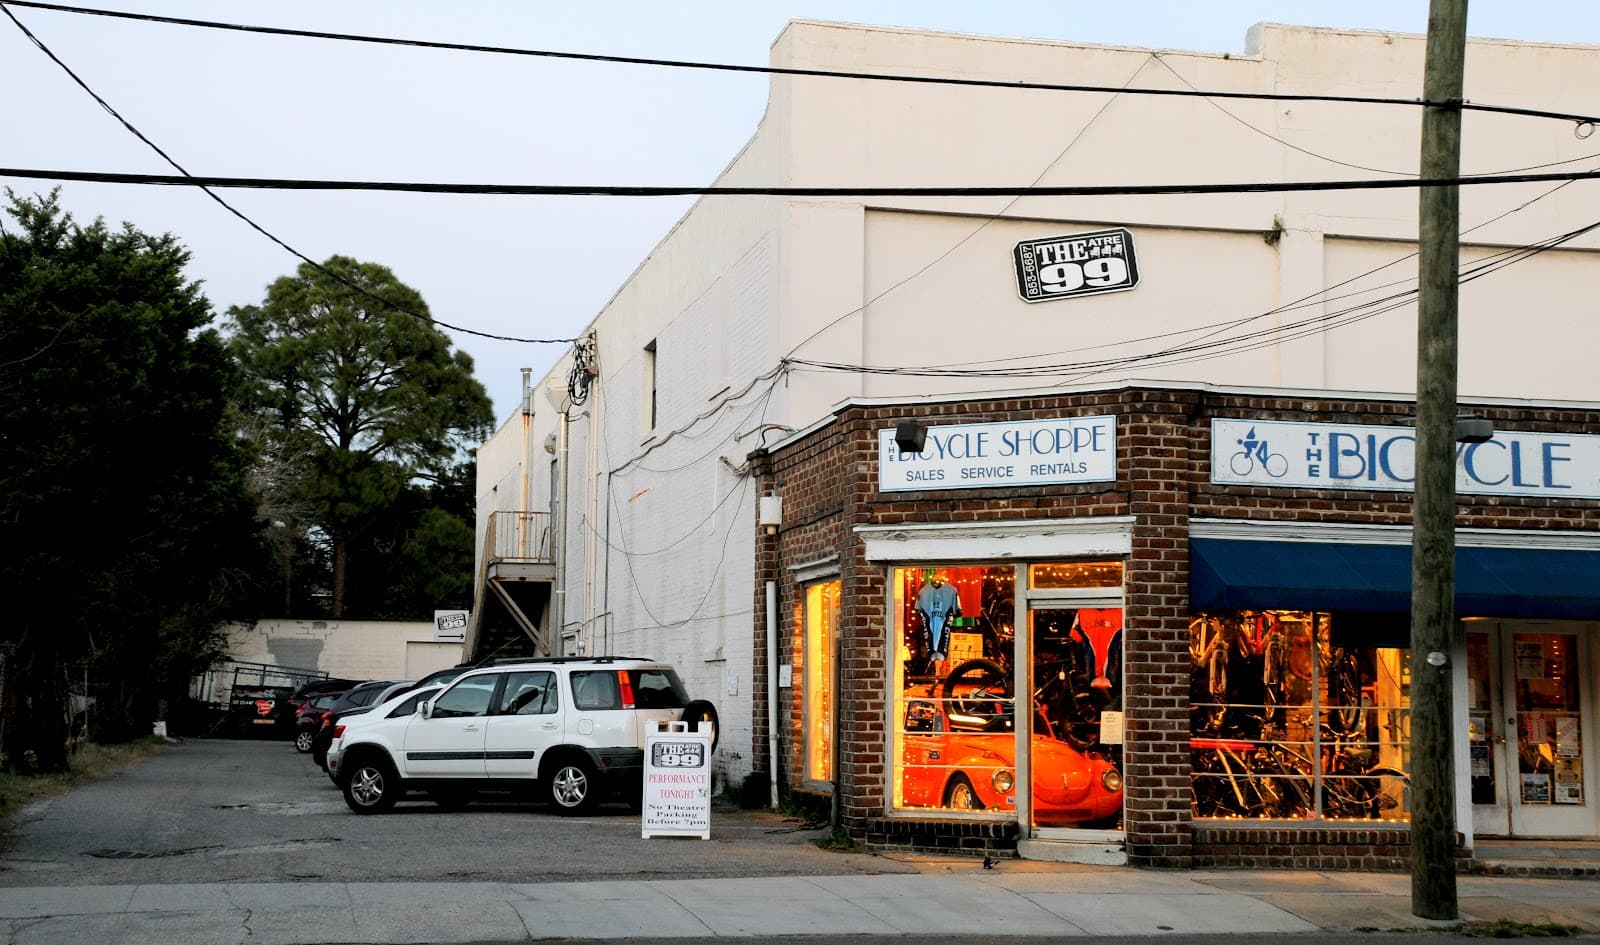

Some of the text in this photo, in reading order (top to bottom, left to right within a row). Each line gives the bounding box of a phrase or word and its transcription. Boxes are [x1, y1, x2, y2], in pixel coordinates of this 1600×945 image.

[1040, 257, 1128, 293] 99
[998, 424, 1106, 457] SHOPPE
[1306, 432, 1572, 489] THE BICCLE
[906, 462, 1088, 482] SALES SERVICE RENTALS
[661, 754, 700, 766] 99
[648, 774, 706, 784] PERFORMANCE
[659, 789, 694, 799] TONIGHT
